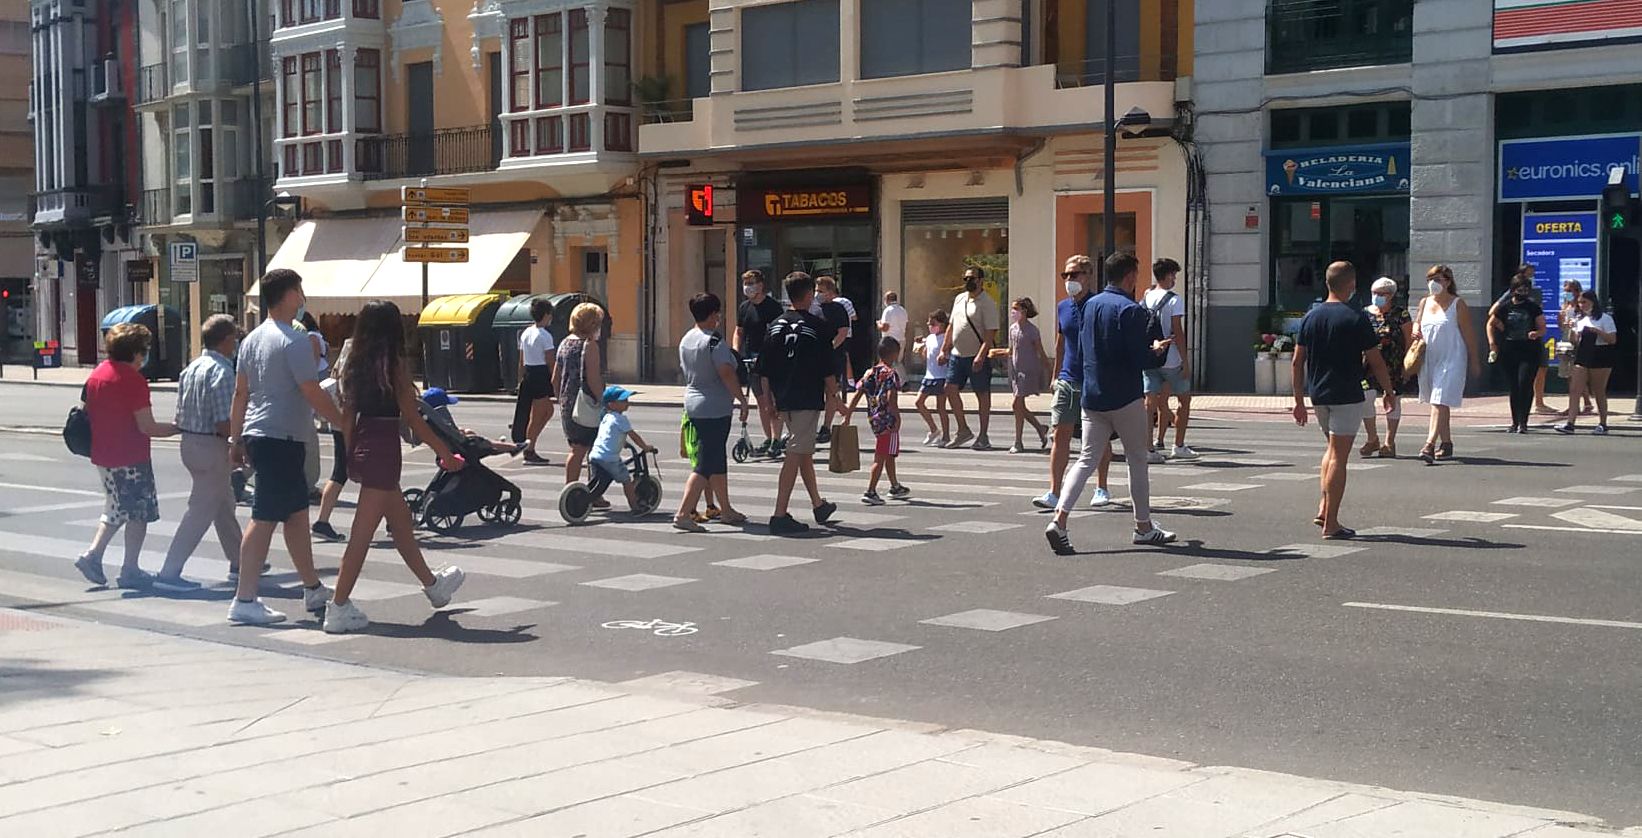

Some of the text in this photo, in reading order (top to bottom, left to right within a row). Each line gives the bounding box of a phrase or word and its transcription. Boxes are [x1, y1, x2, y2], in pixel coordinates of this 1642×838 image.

[1328, 164, 1354, 176] La
[1298, 175, 1385, 189] Valenciana
[782, 192, 848, 209] TABACOS
[1536, 222, 1582, 233] OFERTA
[182, 246, 192, 258] P
